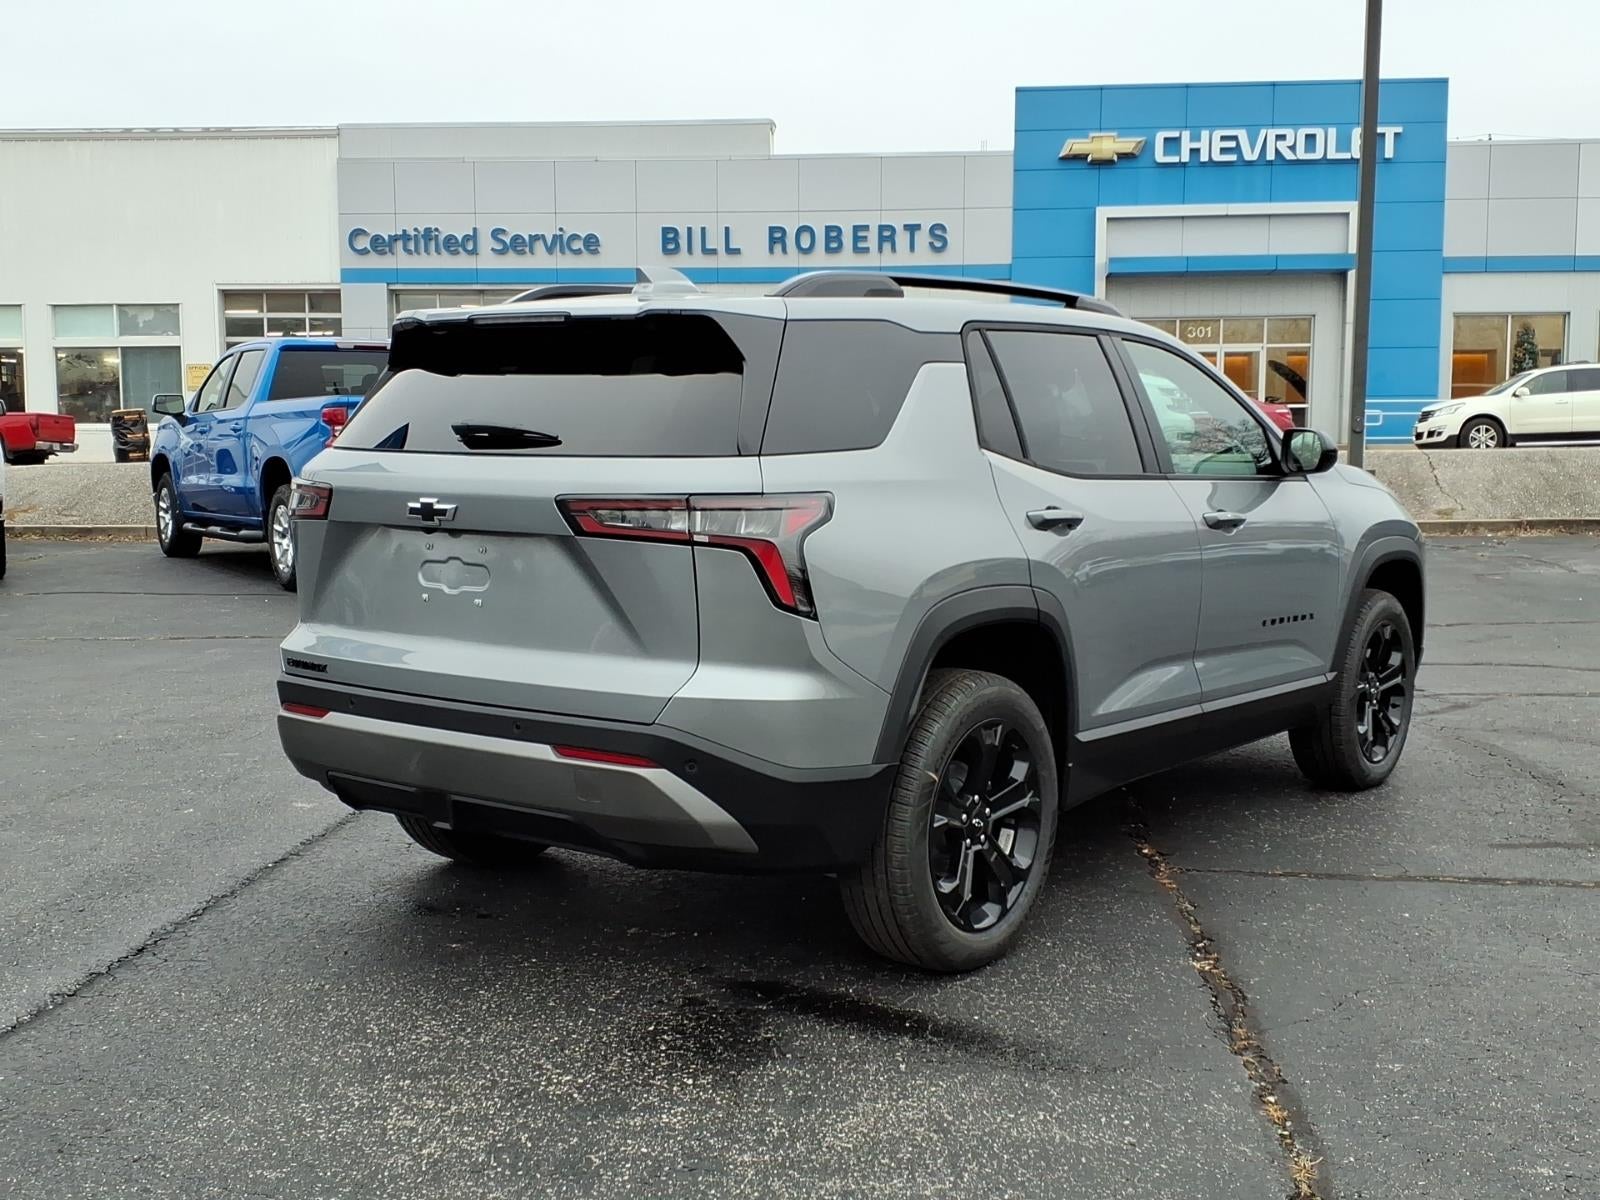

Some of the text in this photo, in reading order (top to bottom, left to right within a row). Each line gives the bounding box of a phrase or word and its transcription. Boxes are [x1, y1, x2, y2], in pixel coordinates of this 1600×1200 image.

[347, 226, 601, 256] Certified Service
[660, 222, 949, 256] BILL ROBERTS
[1186, 326, 1212, 338] 301
